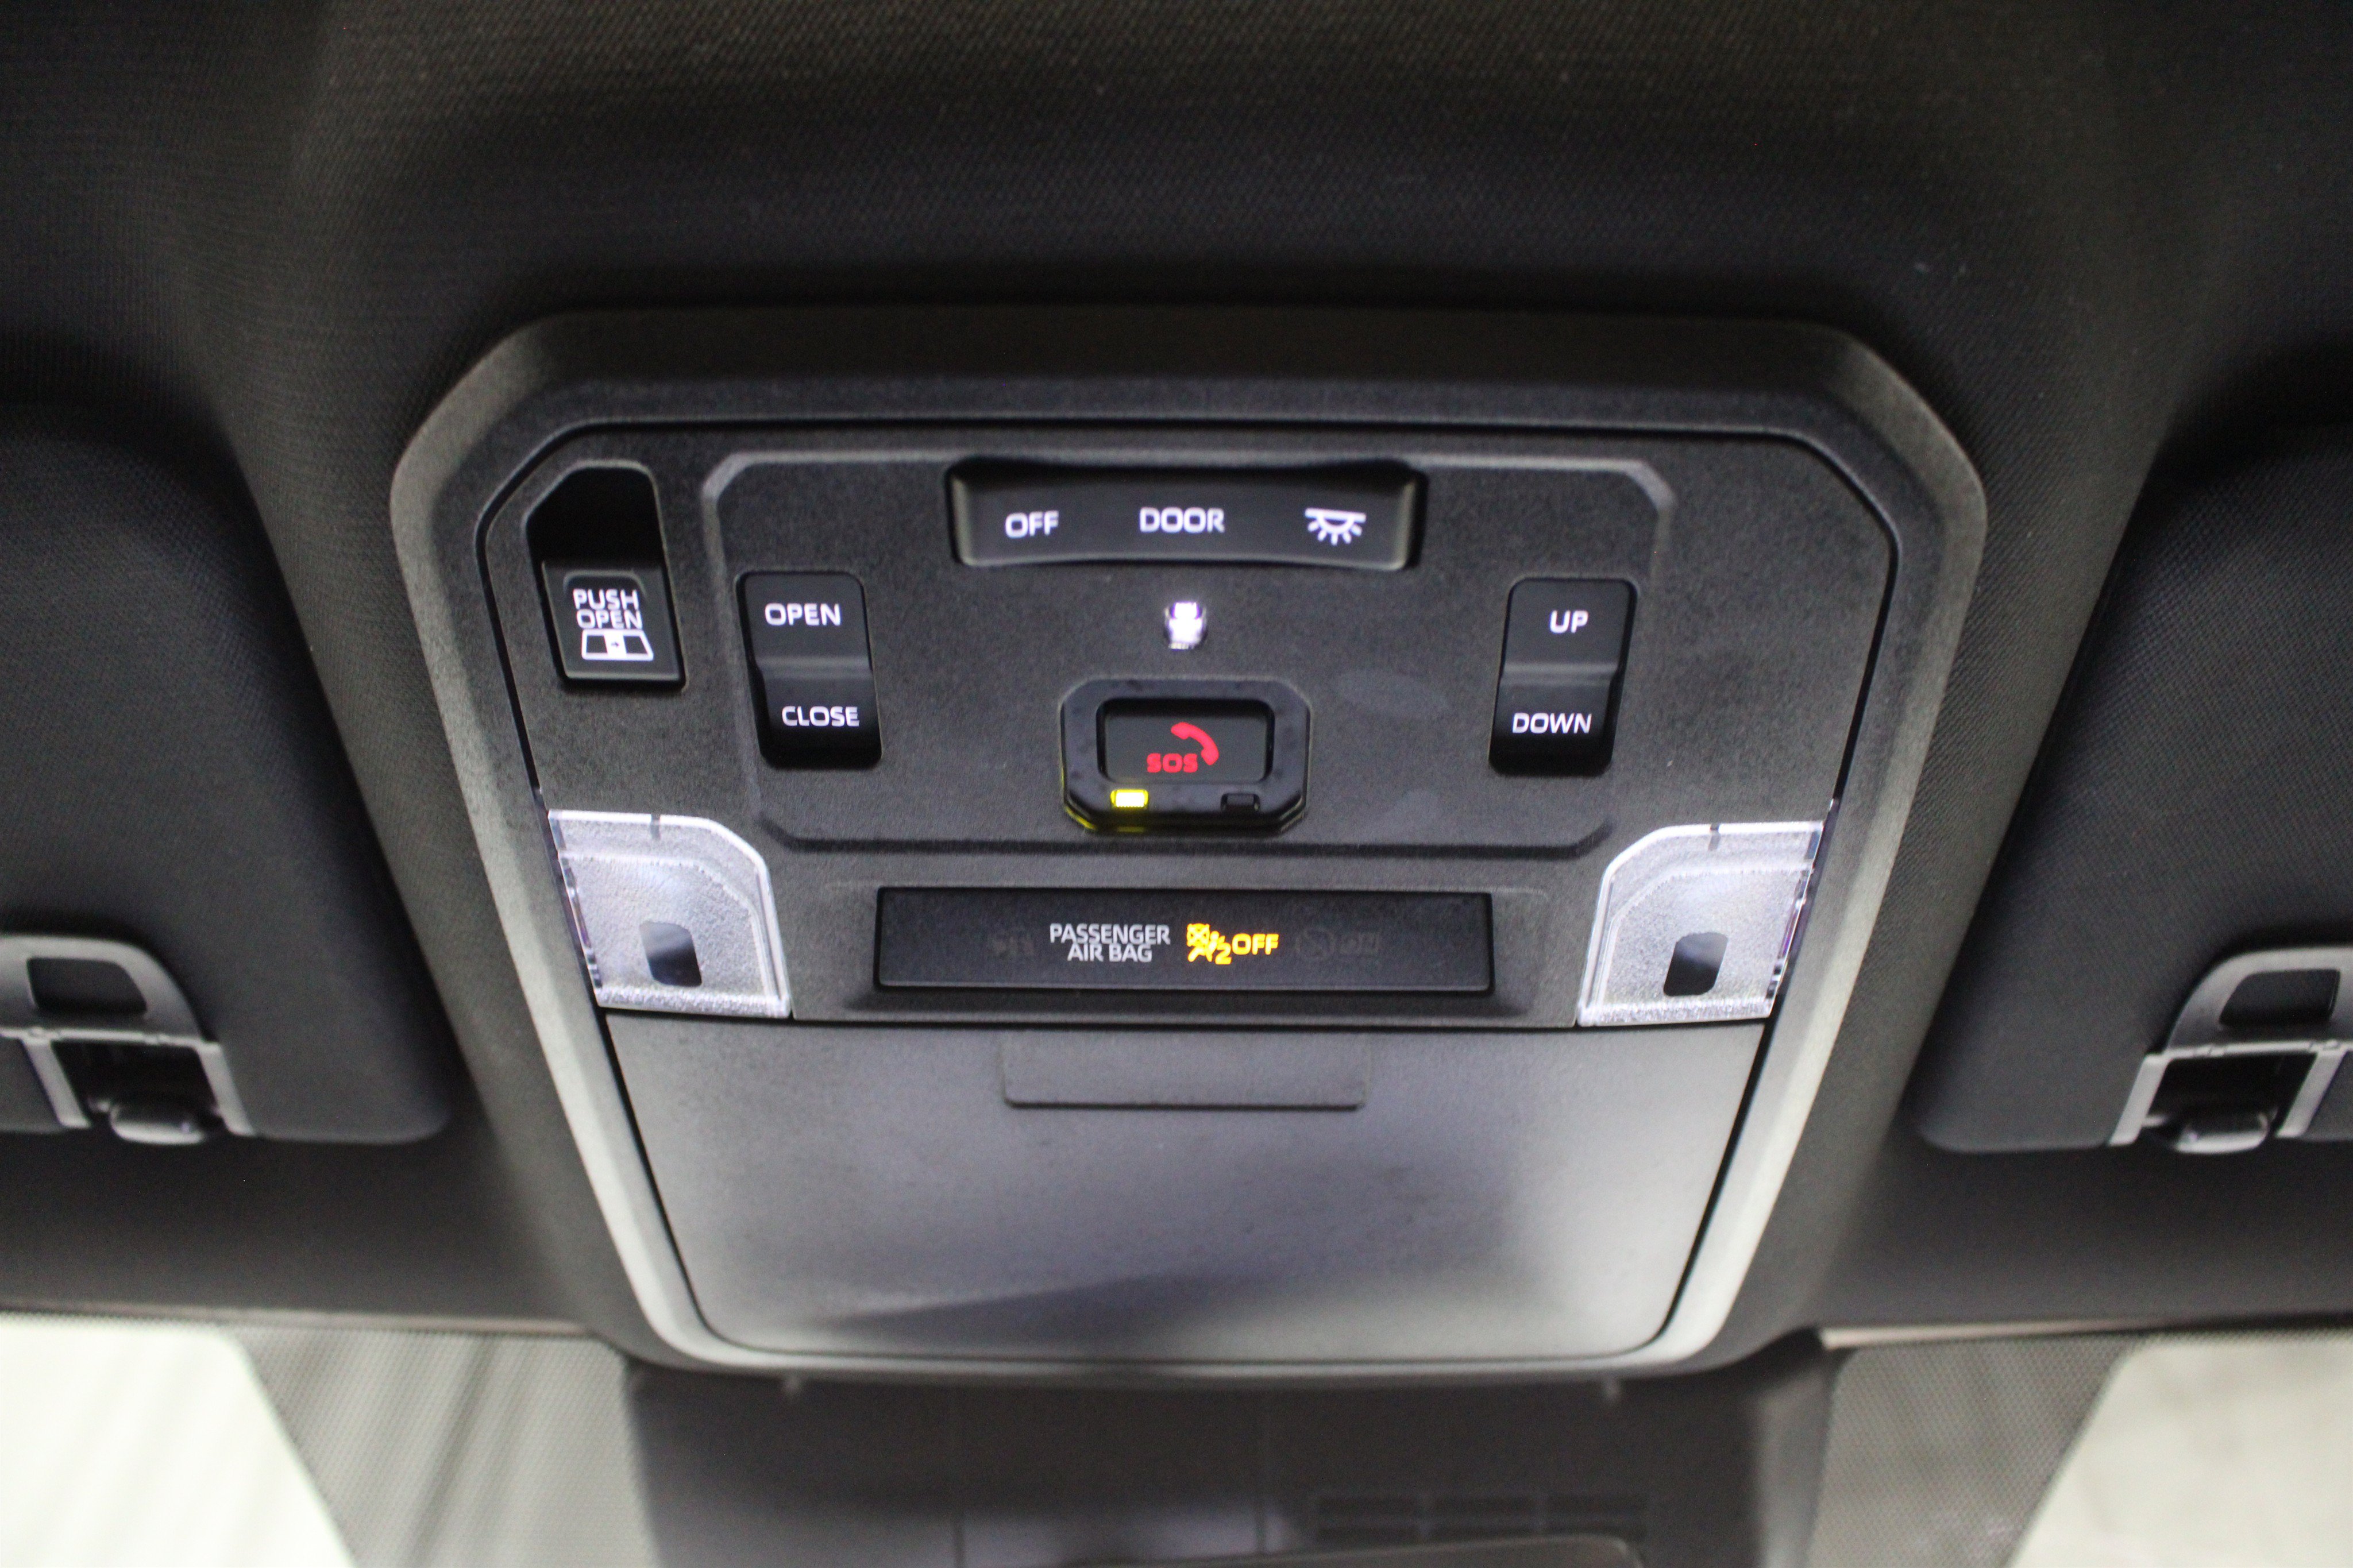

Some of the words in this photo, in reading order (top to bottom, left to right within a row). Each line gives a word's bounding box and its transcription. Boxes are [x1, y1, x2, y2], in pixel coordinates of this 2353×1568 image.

[1004, 511, 1059, 539] OFF
[1139, 507, 1225, 534] DOOR
[573, 589, 639, 611] PUSH
[576, 610, 643, 629] OPEN
[765, 603, 842, 626] OPEN
[1549, 610, 1588, 634] UP
[781, 705, 860, 727] CLOSE
[1512, 712, 1592, 734] DOWN
[1146, 752, 1198, 773] SOS
[1050, 923, 1171, 945] PASSENGER
[1232, 933, 1279, 955] OFF
[1067, 943, 1104, 961] AIR
[1109, 944, 1152, 963] BAG
